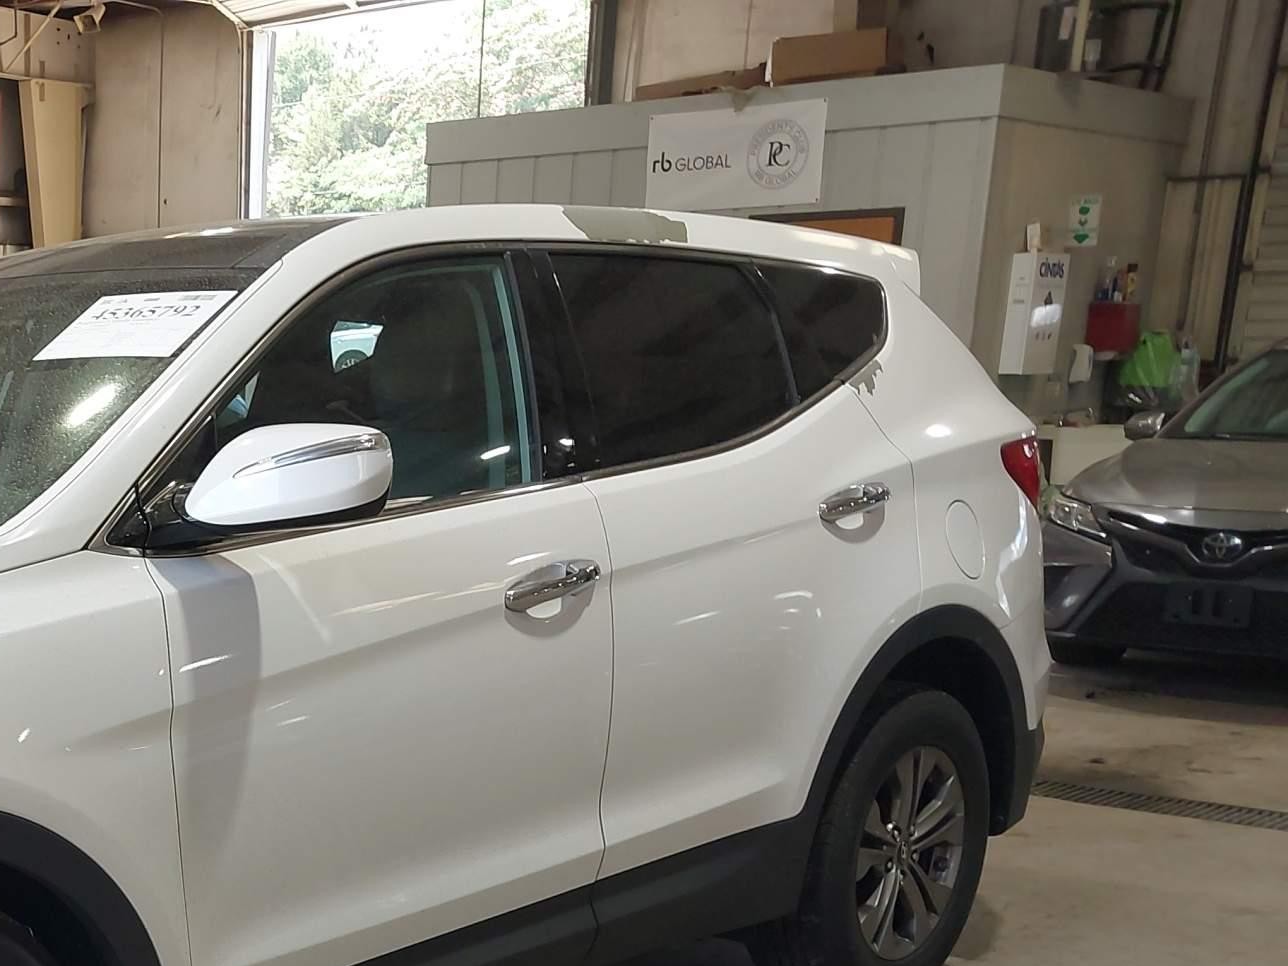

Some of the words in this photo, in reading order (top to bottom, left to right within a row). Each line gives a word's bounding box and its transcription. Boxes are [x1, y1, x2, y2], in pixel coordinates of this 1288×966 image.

[652, 152, 672, 173] rb
[675, 153, 732, 173] GLOBAL
[91, 305, 201, 320] 45365792
